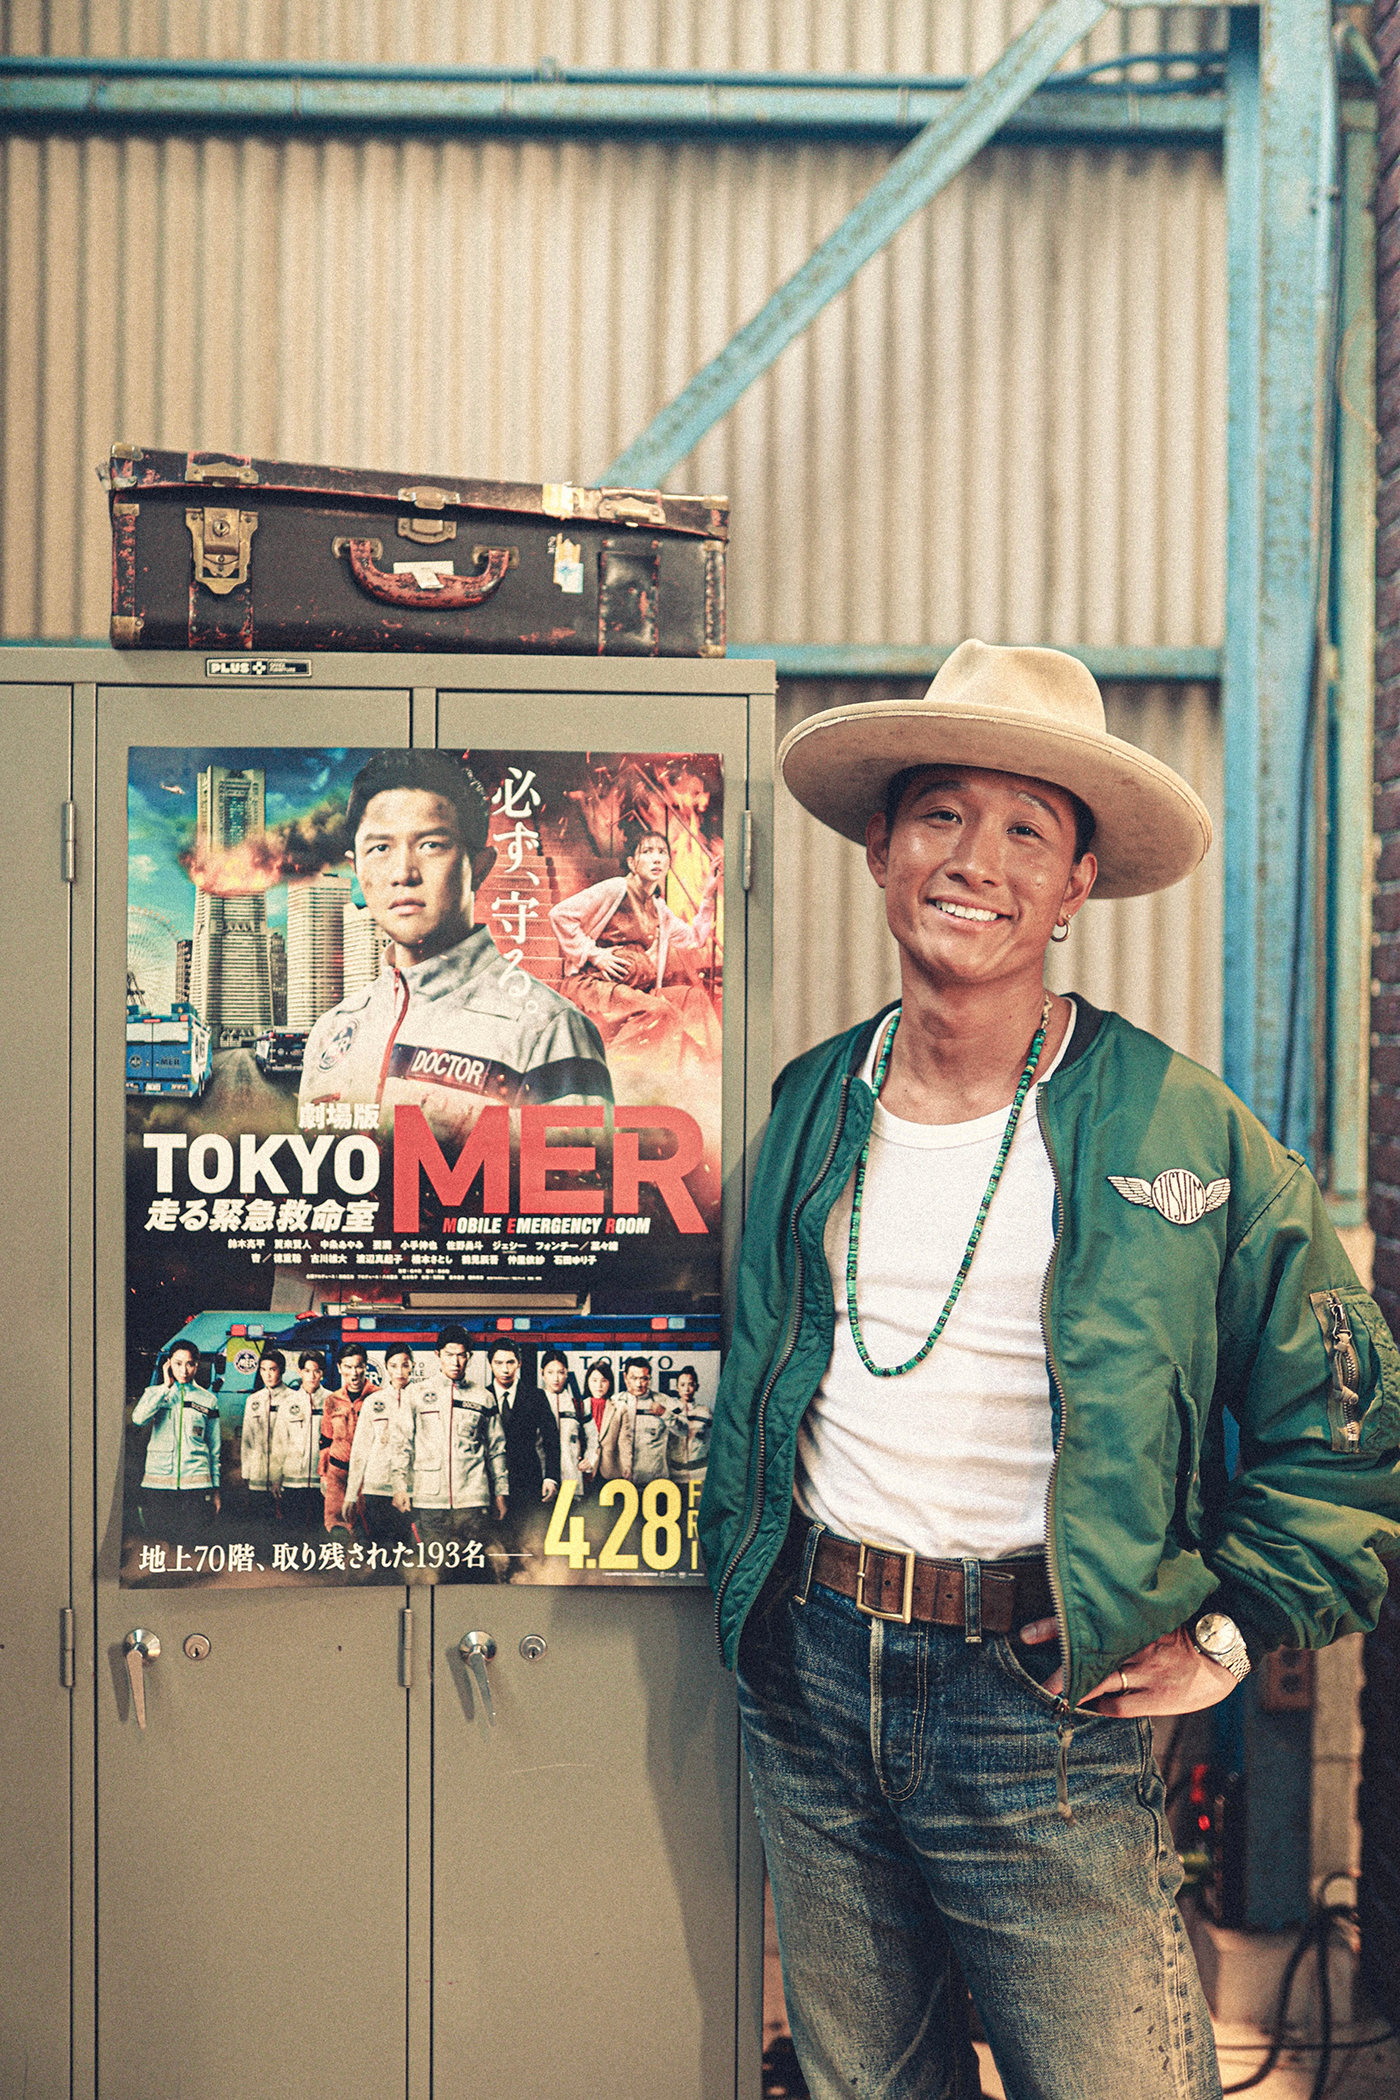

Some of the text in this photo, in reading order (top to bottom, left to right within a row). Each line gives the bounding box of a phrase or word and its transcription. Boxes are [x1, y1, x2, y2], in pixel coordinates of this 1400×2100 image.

[211, 662, 250, 674] PLUS
[491, 767, 541, 1014] 必ず、守る。
[411, 1050, 485, 1086] DOCTOR
[298, 1103, 380, 1130] 劇場版
[143, 1105, 709, 1234] TOKYO MER
[144, 1198, 380, 1233] 走る緊急救命室
[442, 1217, 651, 1234] MOBILE EMERGENCY ROOM
[544, 1478, 682, 1570] 4.28
